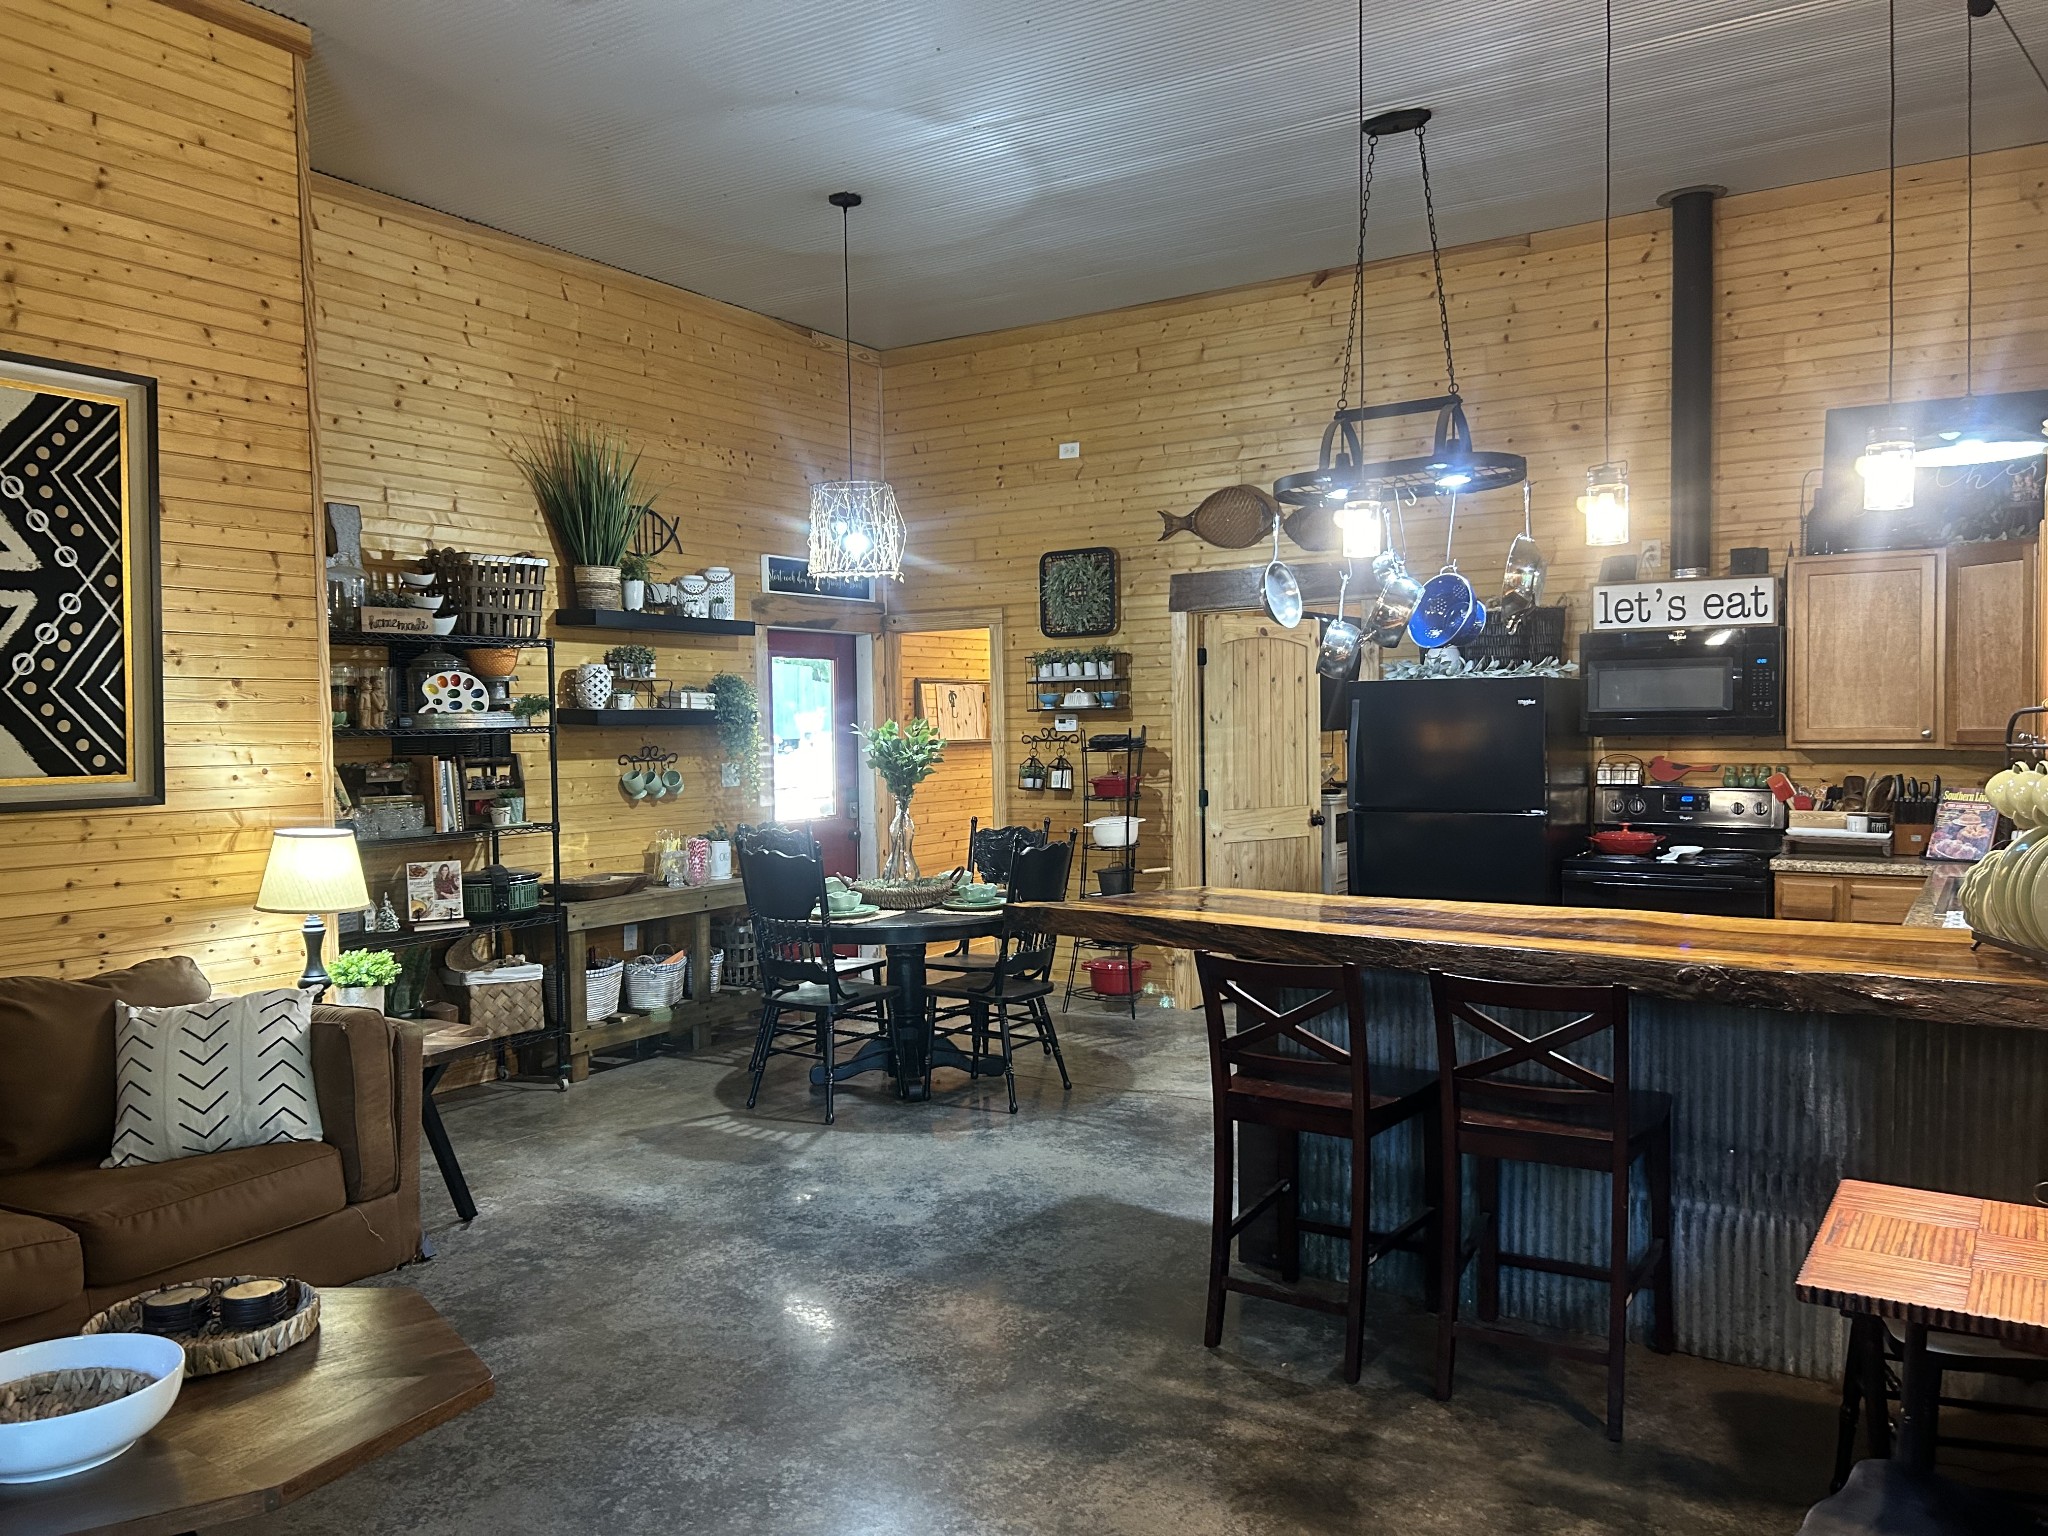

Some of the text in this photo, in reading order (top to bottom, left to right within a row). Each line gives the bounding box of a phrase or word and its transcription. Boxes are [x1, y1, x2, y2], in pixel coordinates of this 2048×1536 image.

[1599, 585, 1768, 624] let's eat
[1943, 790, 1989, 802] Southern Liv
